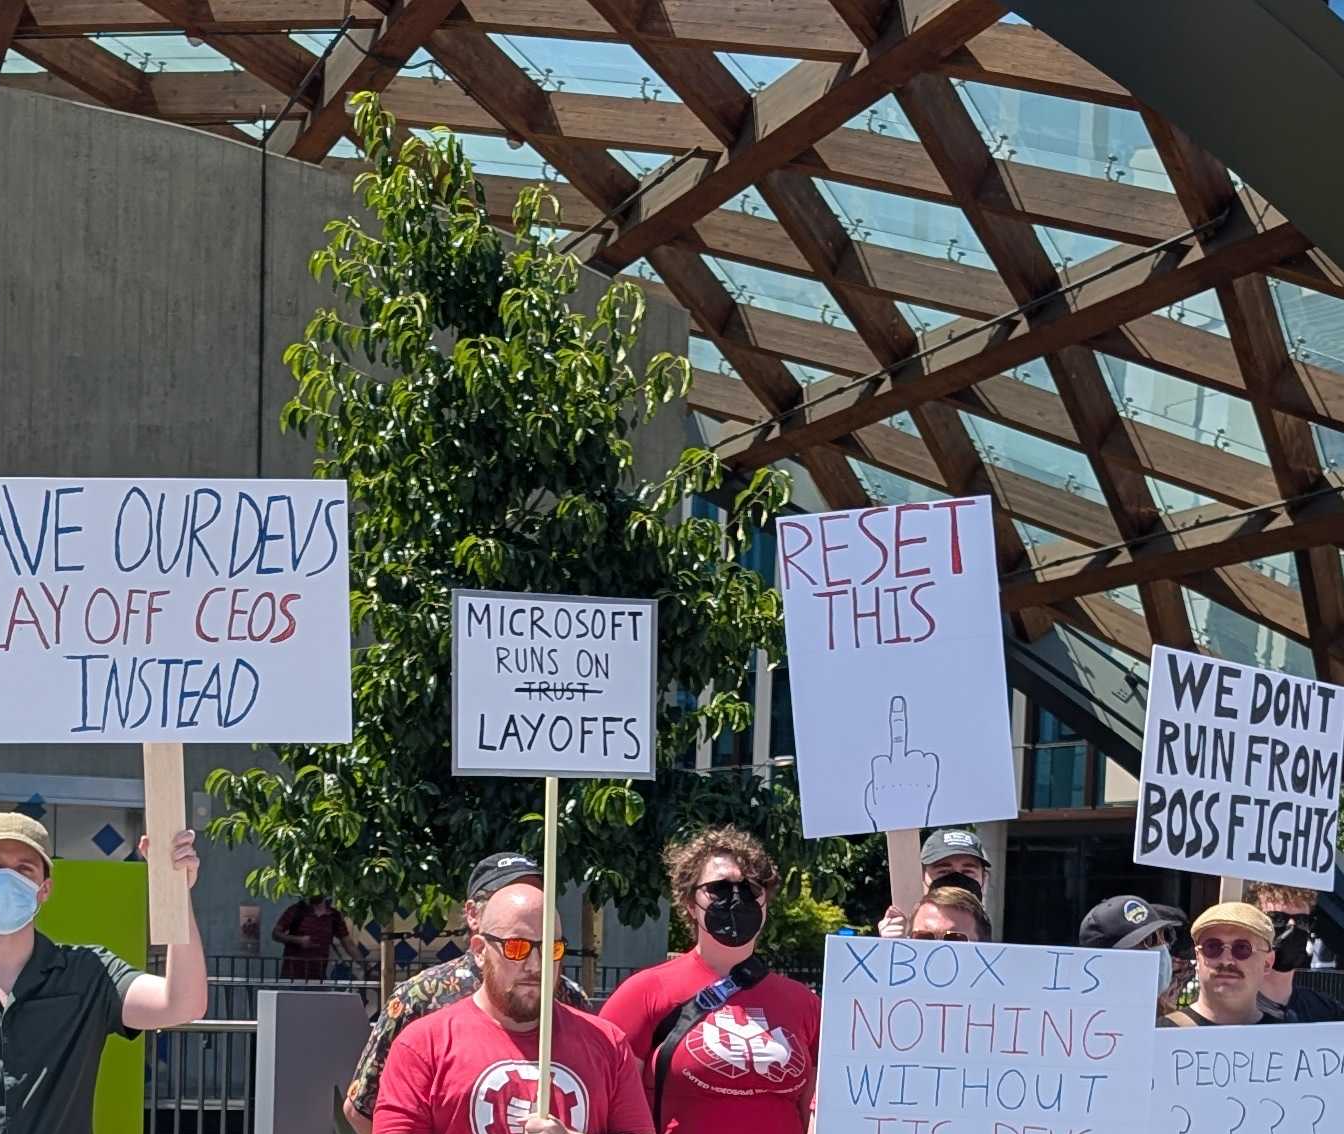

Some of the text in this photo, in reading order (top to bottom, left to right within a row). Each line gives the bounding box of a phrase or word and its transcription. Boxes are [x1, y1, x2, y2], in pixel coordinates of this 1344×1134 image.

[778, 500, 975, 590] RESET
[85, 588, 170, 646] OFF
[196, 588, 302, 643] CEOS
[467, 603, 642, 642] MICROSOFT
[812, 581, 935, 650] THIS
[496, 647, 609, 679] RUNS ON
[514, 681, 603, 702] TRUST
[64, 655, 259, 733] INSTEAD
[1168, 653, 1337, 732] WE DON'T
[479, 713, 641, 760] LAYOFFS
[1156, 719, 1341, 801] RUN FROM
[1140, 781, 1339, 875] BOSS FIGHTS
[842, 942, 1102, 993] XBOX IS
[851, 998, 1123, 1060] NOTHING
[846, 1064, 1108, 1113] WITHOUT
[1171, 1049, 1283, 1088] PEOPLE
